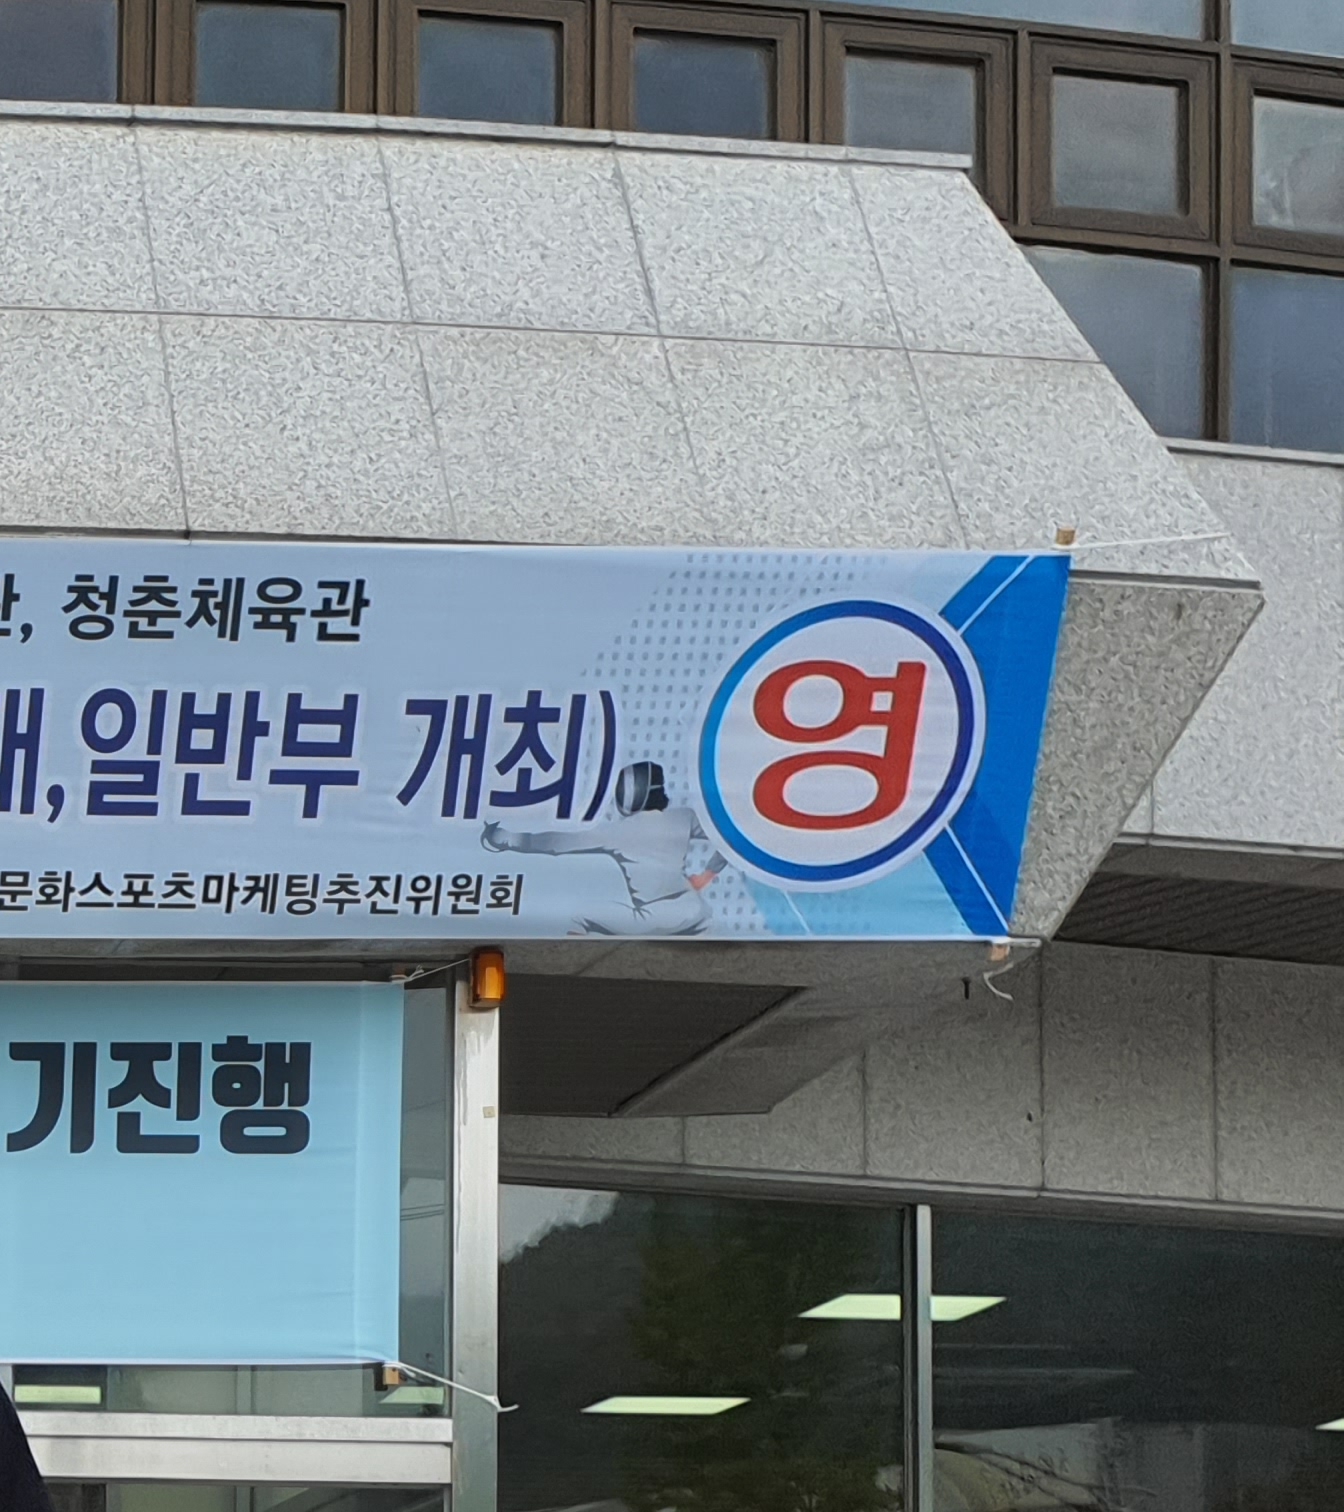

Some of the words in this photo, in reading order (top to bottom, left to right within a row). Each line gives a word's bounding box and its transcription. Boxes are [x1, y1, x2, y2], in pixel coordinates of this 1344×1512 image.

[61, 573, 370, 642] 청춘체육관
[397, 690, 617, 822] 개최)
[753, 659, 926, 830] 영
